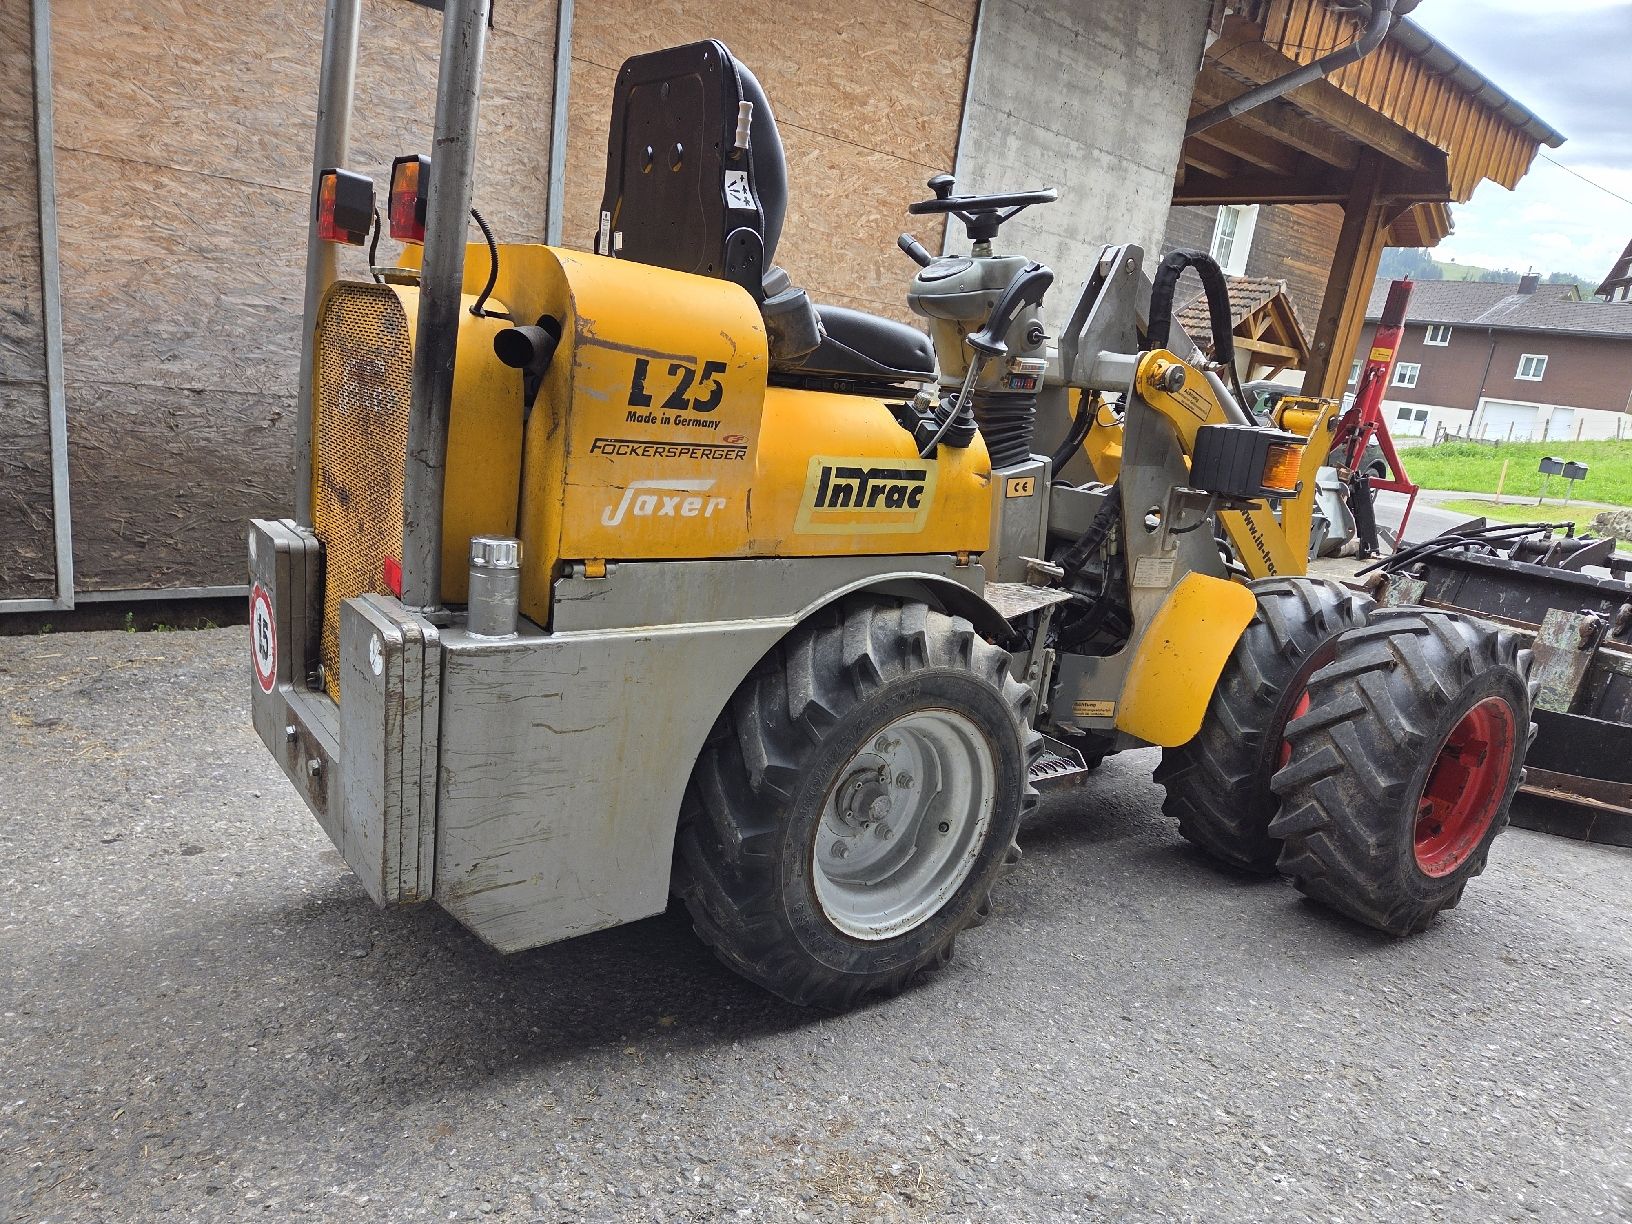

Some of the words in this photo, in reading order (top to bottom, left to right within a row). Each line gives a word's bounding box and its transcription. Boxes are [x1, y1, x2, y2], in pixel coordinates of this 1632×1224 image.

[627, 357, 653, 407] L
[660, 360, 727, 412] 25
[625, 410, 657, 424] Made
[660, 412, 671, 425] in
[673, 414, 720, 430] Germany
[589, 437, 748, 460] FÖCKERSPERGER
[601, 479, 727, 526] Jaxer
[813, 466, 927, 508] InTrac
[257, 613, 269, 661] 15
